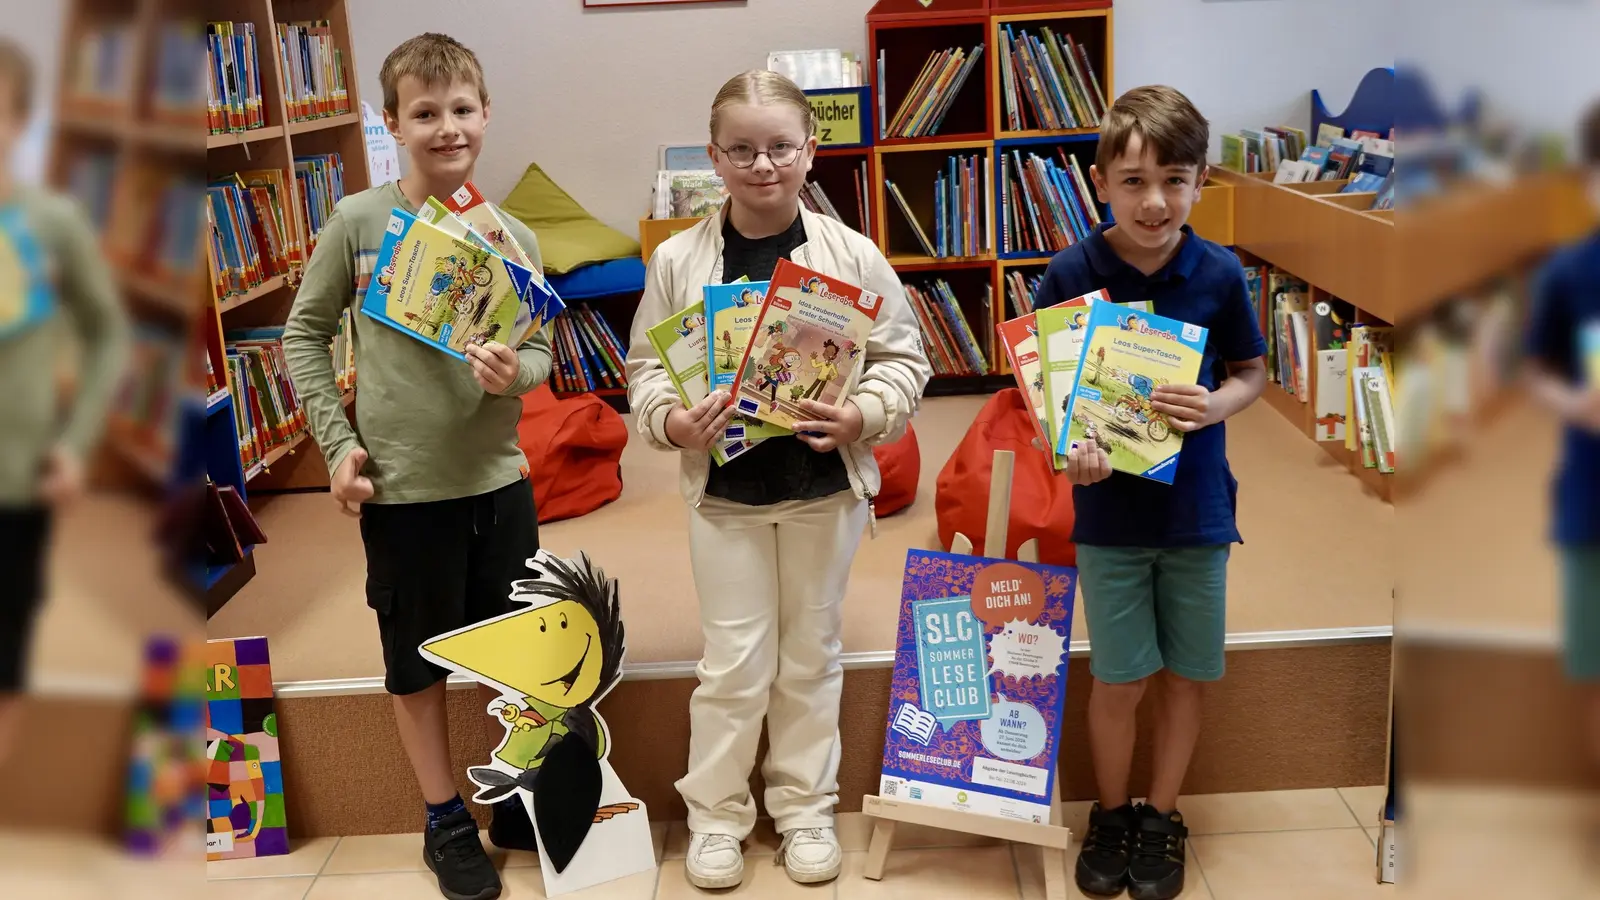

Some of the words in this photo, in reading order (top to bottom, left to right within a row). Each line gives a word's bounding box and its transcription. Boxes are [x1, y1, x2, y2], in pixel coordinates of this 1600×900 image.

[386, 240, 403, 276] Leserabe
[397, 286, 407, 303] Leos
[403, 239, 422, 286] Super-Tasche
[819, 287, 854, 307] Leserabe
[734, 316, 752, 324] Leos
[798, 300, 812, 310] Idas
[812, 305, 851, 324] zauberhafter
[799, 309, 817, 320] erster
[818, 315, 845, 331] Schultag
[1140, 323, 1177, 341] Leserabe
[1113, 338, 1131, 348] Leos
[1133, 342, 1182, 362] Super-Tasche
[985, 596, 1012, 609] DICH
[1013, 595, 1032, 607] AN!
[925, 611, 973, 644] SLC
[1017, 632, 1039, 645] WO?
[929, 648, 975, 663] SOMMER
[931, 664, 977, 685] LESE
[934, 687, 979, 708] CLUB
[999, 718, 1027, 730] WANN?
[1009, 709, 1020, 719] AB
[898, 750, 961, 769] SOMMERLESECLUB.DE
